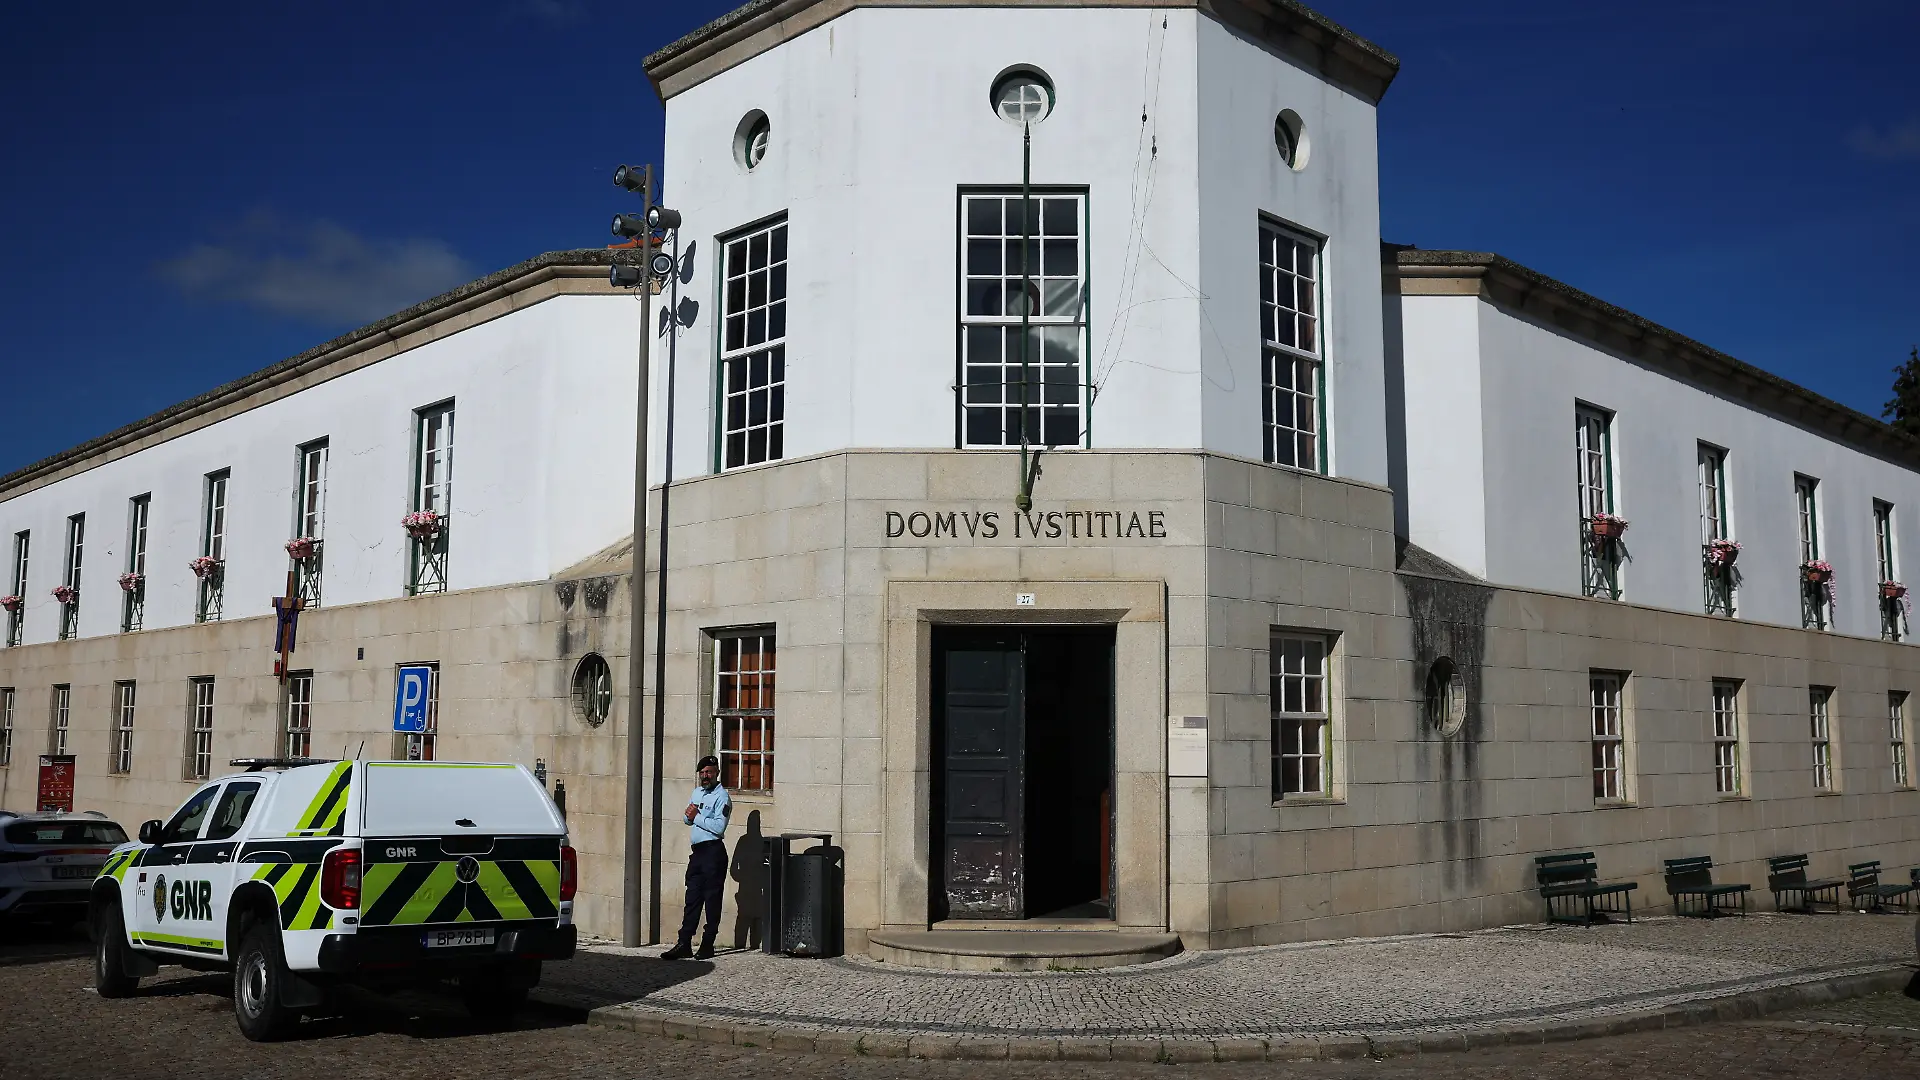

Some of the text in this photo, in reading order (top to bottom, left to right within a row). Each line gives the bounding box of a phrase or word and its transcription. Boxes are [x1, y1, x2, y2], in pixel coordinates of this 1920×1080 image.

[885, 511, 1167, 539] DOMVS IVSTITIAE
[1021, 595, 1030, 604] 27
[399, 674, 422, 725] P
[386, 847, 417, 858] GNR
[170, 879, 213, 921] GNR
[437, 931, 456, 946] BP
[458, 931, 472, 944] 78
